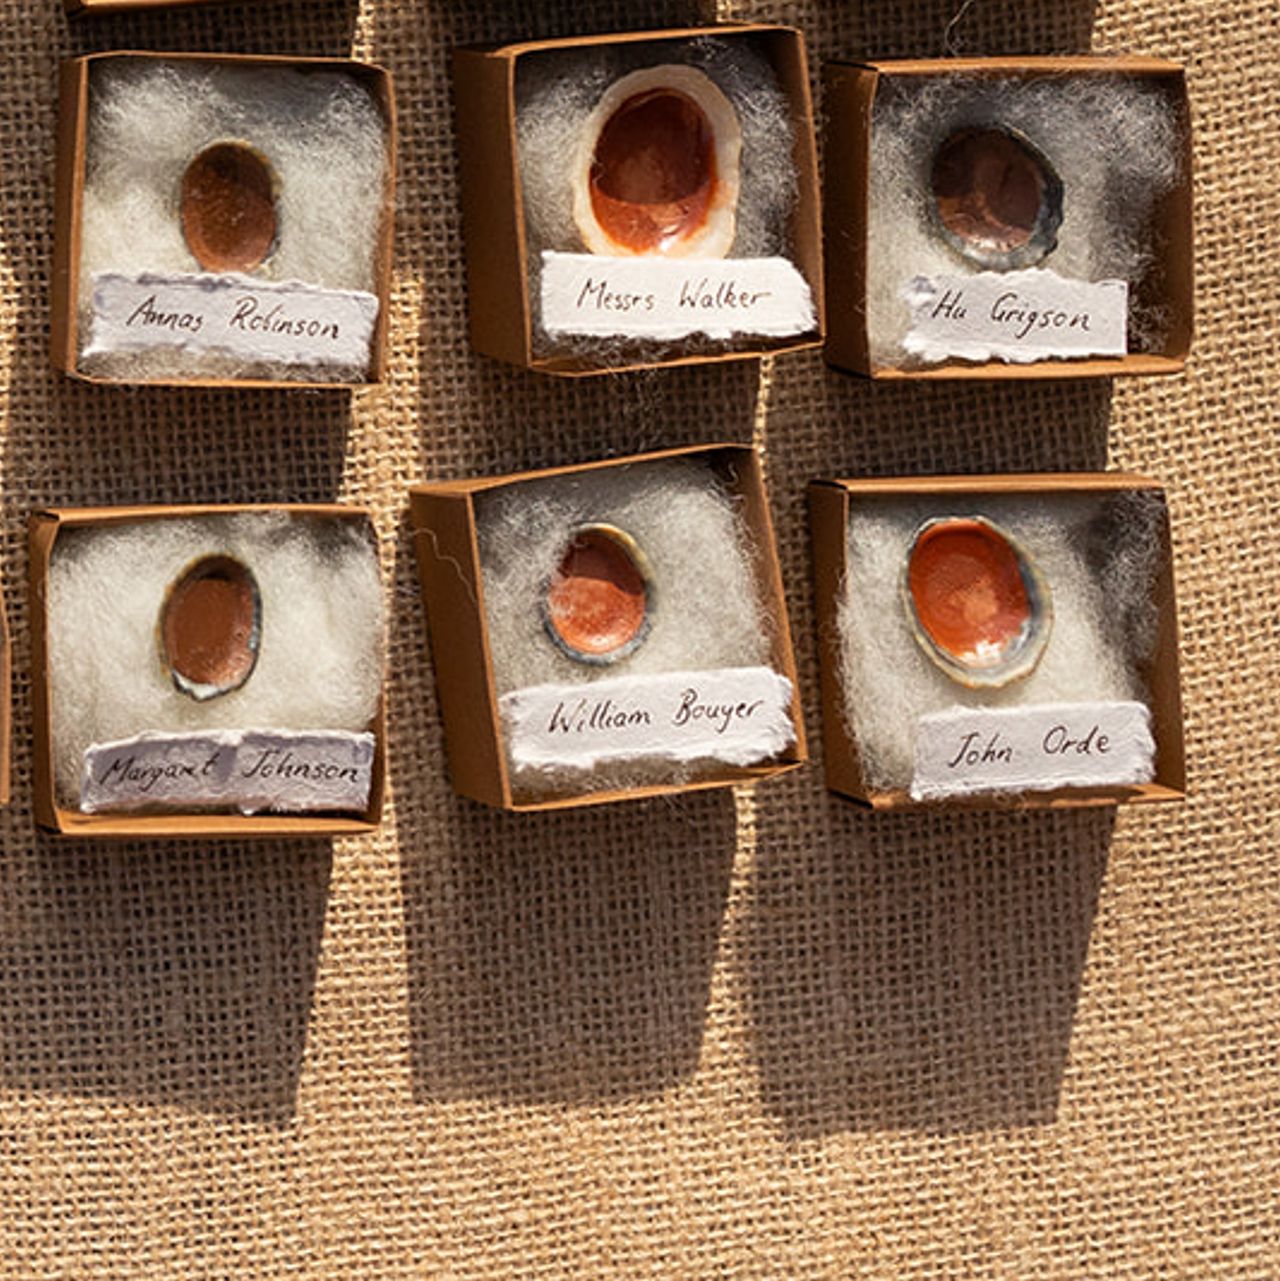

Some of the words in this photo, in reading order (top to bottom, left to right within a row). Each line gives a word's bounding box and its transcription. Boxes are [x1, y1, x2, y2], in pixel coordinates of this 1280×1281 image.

[576, 280, 654, 309] Messrs
[678, 278, 771, 308] Walker
[126, 296, 202, 331] Annas
[231, 297, 339, 338] Robinson
[991, 294, 1090, 337] Grigson
[549, 701, 651, 733] William
[673, 689, 764, 735] Bouyer
[949, 732, 1013, 768] John
[1042, 725, 1109, 754] Orde
[99, 753, 218, 791] Margaret
[241, 749, 359, 782] Johnson
